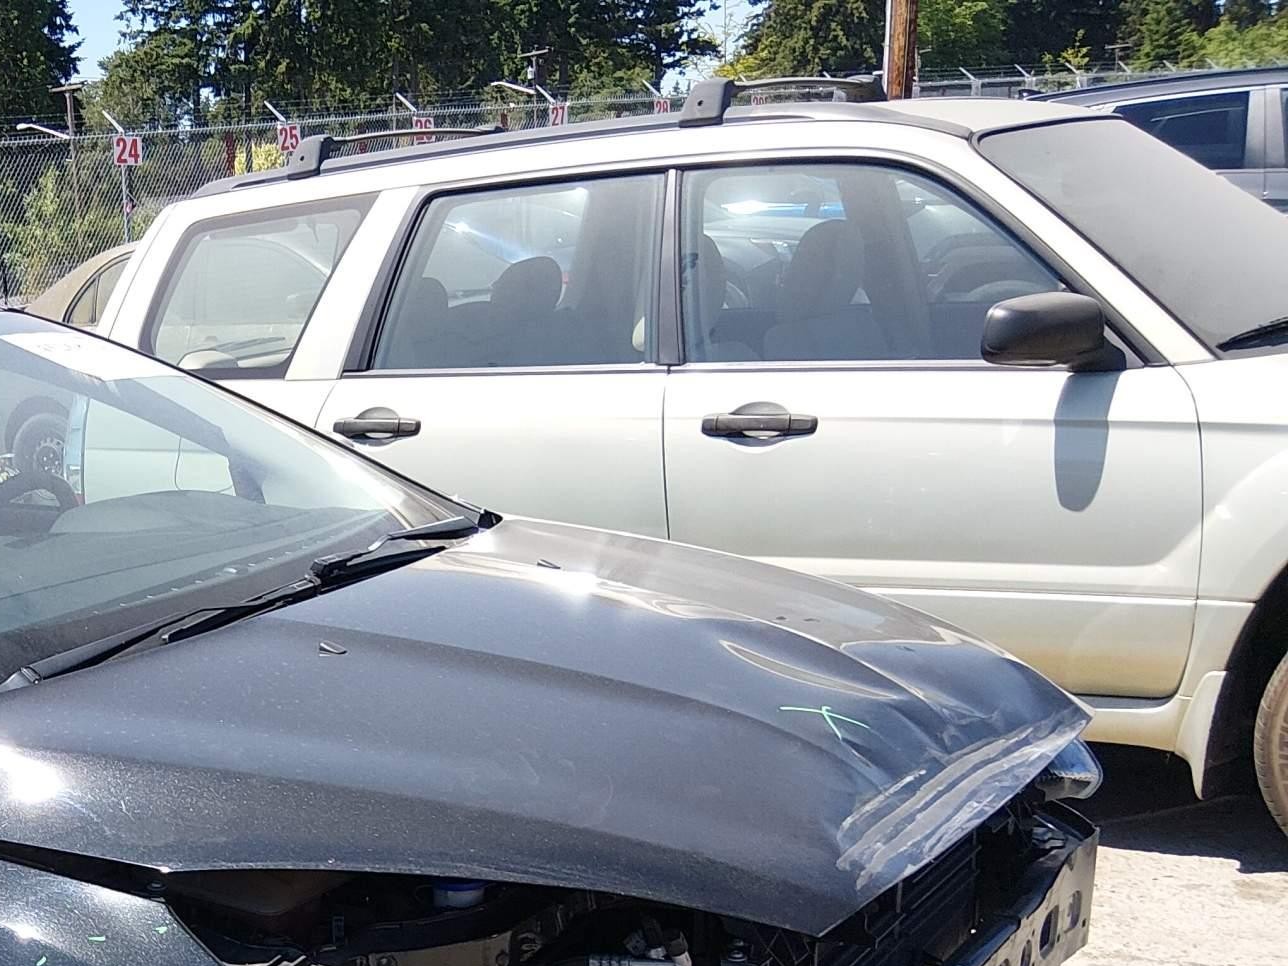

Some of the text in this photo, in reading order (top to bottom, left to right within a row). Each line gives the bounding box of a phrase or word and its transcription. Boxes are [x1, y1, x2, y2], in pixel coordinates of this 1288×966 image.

[552, 105, 565, 127] 27
[279, 125, 299, 151] 25
[414, 118, 433, 144] 26
[115, 137, 140, 164] 24
